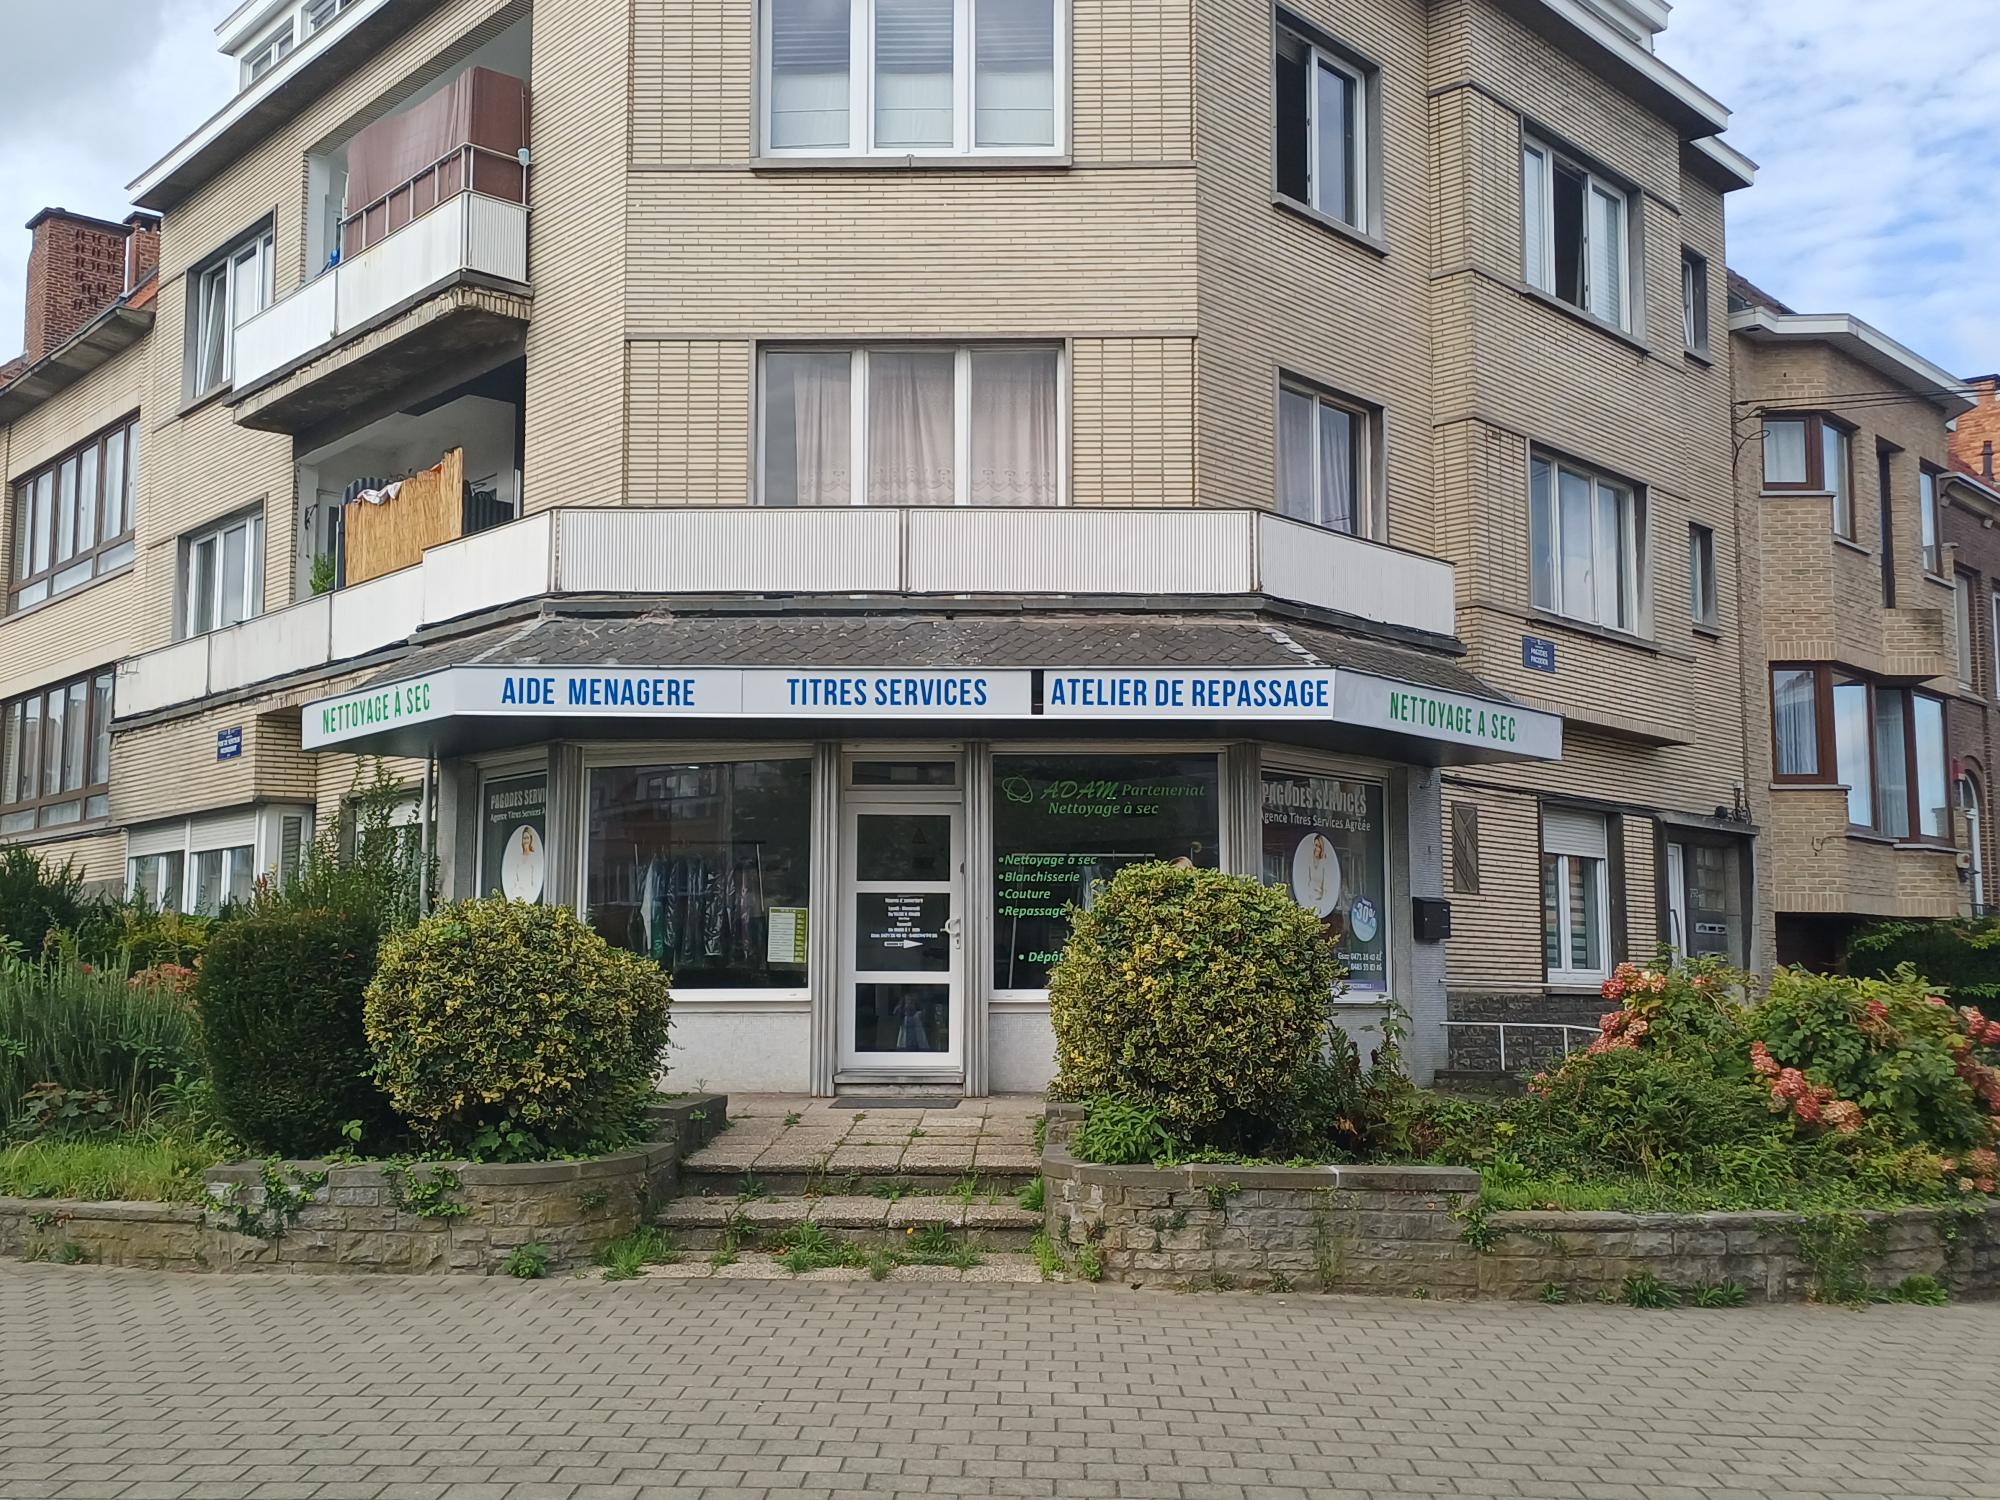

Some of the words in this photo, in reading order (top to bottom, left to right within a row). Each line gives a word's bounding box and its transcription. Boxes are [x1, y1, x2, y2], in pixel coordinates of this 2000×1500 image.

[501, 677, 555, 705] AIDE
[568, 678, 695, 706] MENAGERE
[787, 678, 867, 706] TITRES
[874, 678, 987, 706] SERVICES
[1051, 678, 1147, 706] ATELIER
[1155, 679, 1183, 706] DE
[1193, 679, 1329, 707] REPASSAGE
[322, 693, 390, 735] NETTOYAGE
[393, 685, 402, 719] À
[406, 683, 431, 714] SEC
[1390, 691, 1472, 735] NETTOYAGE
[1477, 713, 1486, 737] A
[1491, 714, 1516, 743] SEC
[1040, 780, 1119, 799] ADAM
[1262, 783, 1313, 809] PAGODES
[1315, 787, 1367, 814] SERVICES
[490, 791, 523, 810] PAGODES
[1049, 802, 1120, 817] Nettoyage
[1124, 802, 1133, 814] à
[1136, 804, 1159, 814] sec
[1289, 813, 1311, 826] Titres
[1313, 815, 1344, 828] Services
[1004, 856, 1065, 867] Nettoyage
[1078, 857, 1098, 865] sec
[1004, 871, 1080, 882] Blanchisserie
[1004, 888, 1051, 899] Couture
[1004, 905, 1067, 918] Repassage
[1028, 951, 1064, 965] Dépôt
